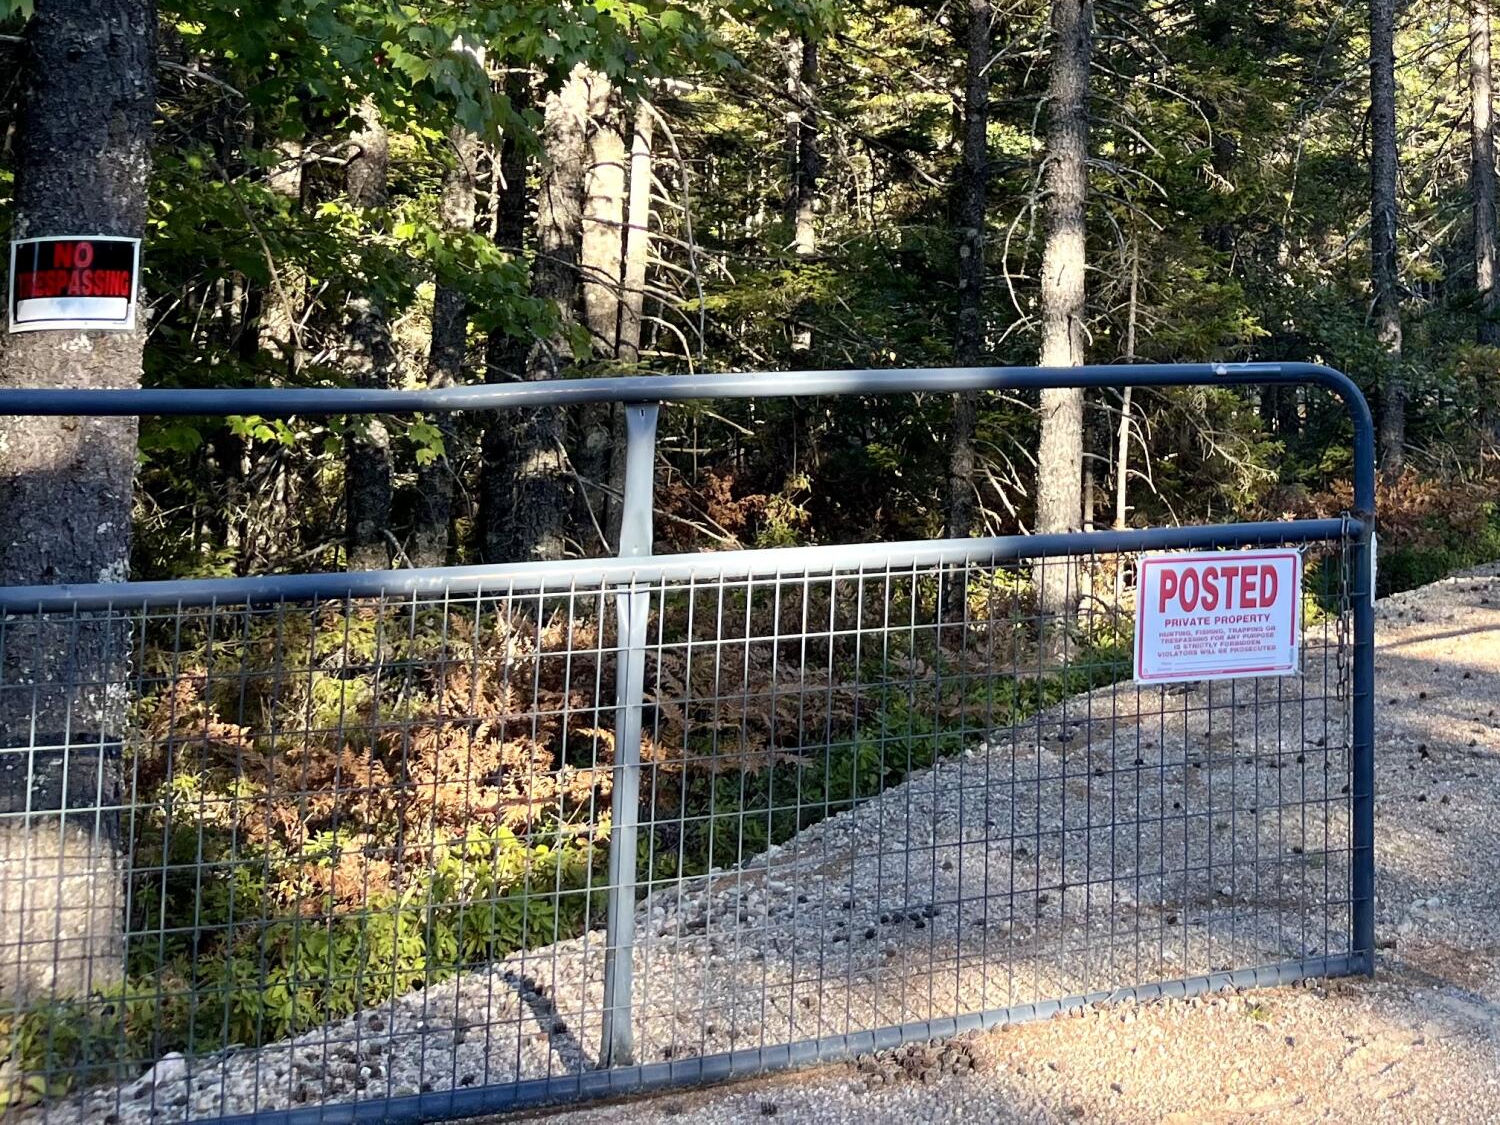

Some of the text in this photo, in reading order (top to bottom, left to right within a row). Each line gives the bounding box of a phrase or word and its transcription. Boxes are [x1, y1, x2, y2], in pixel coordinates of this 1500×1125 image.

[54, 241, 94, 268] NO
[1159, 565, 1278, 614] POSTED
[1164, 613, 1271, 628] PRIVATE PROPERTY
[1228, 626, 1264, 634] TRAPPING
[1160, 636, 1208, 644] TRESPASSING
[1183, 642, 1218, 650] STRICTLY
[1220, 639, 1261, 647] FORBIDDEN
[1157, 650, 1198, 658] VIOLATORS
[1230, 644, 1277, 653] PROSECUTED
